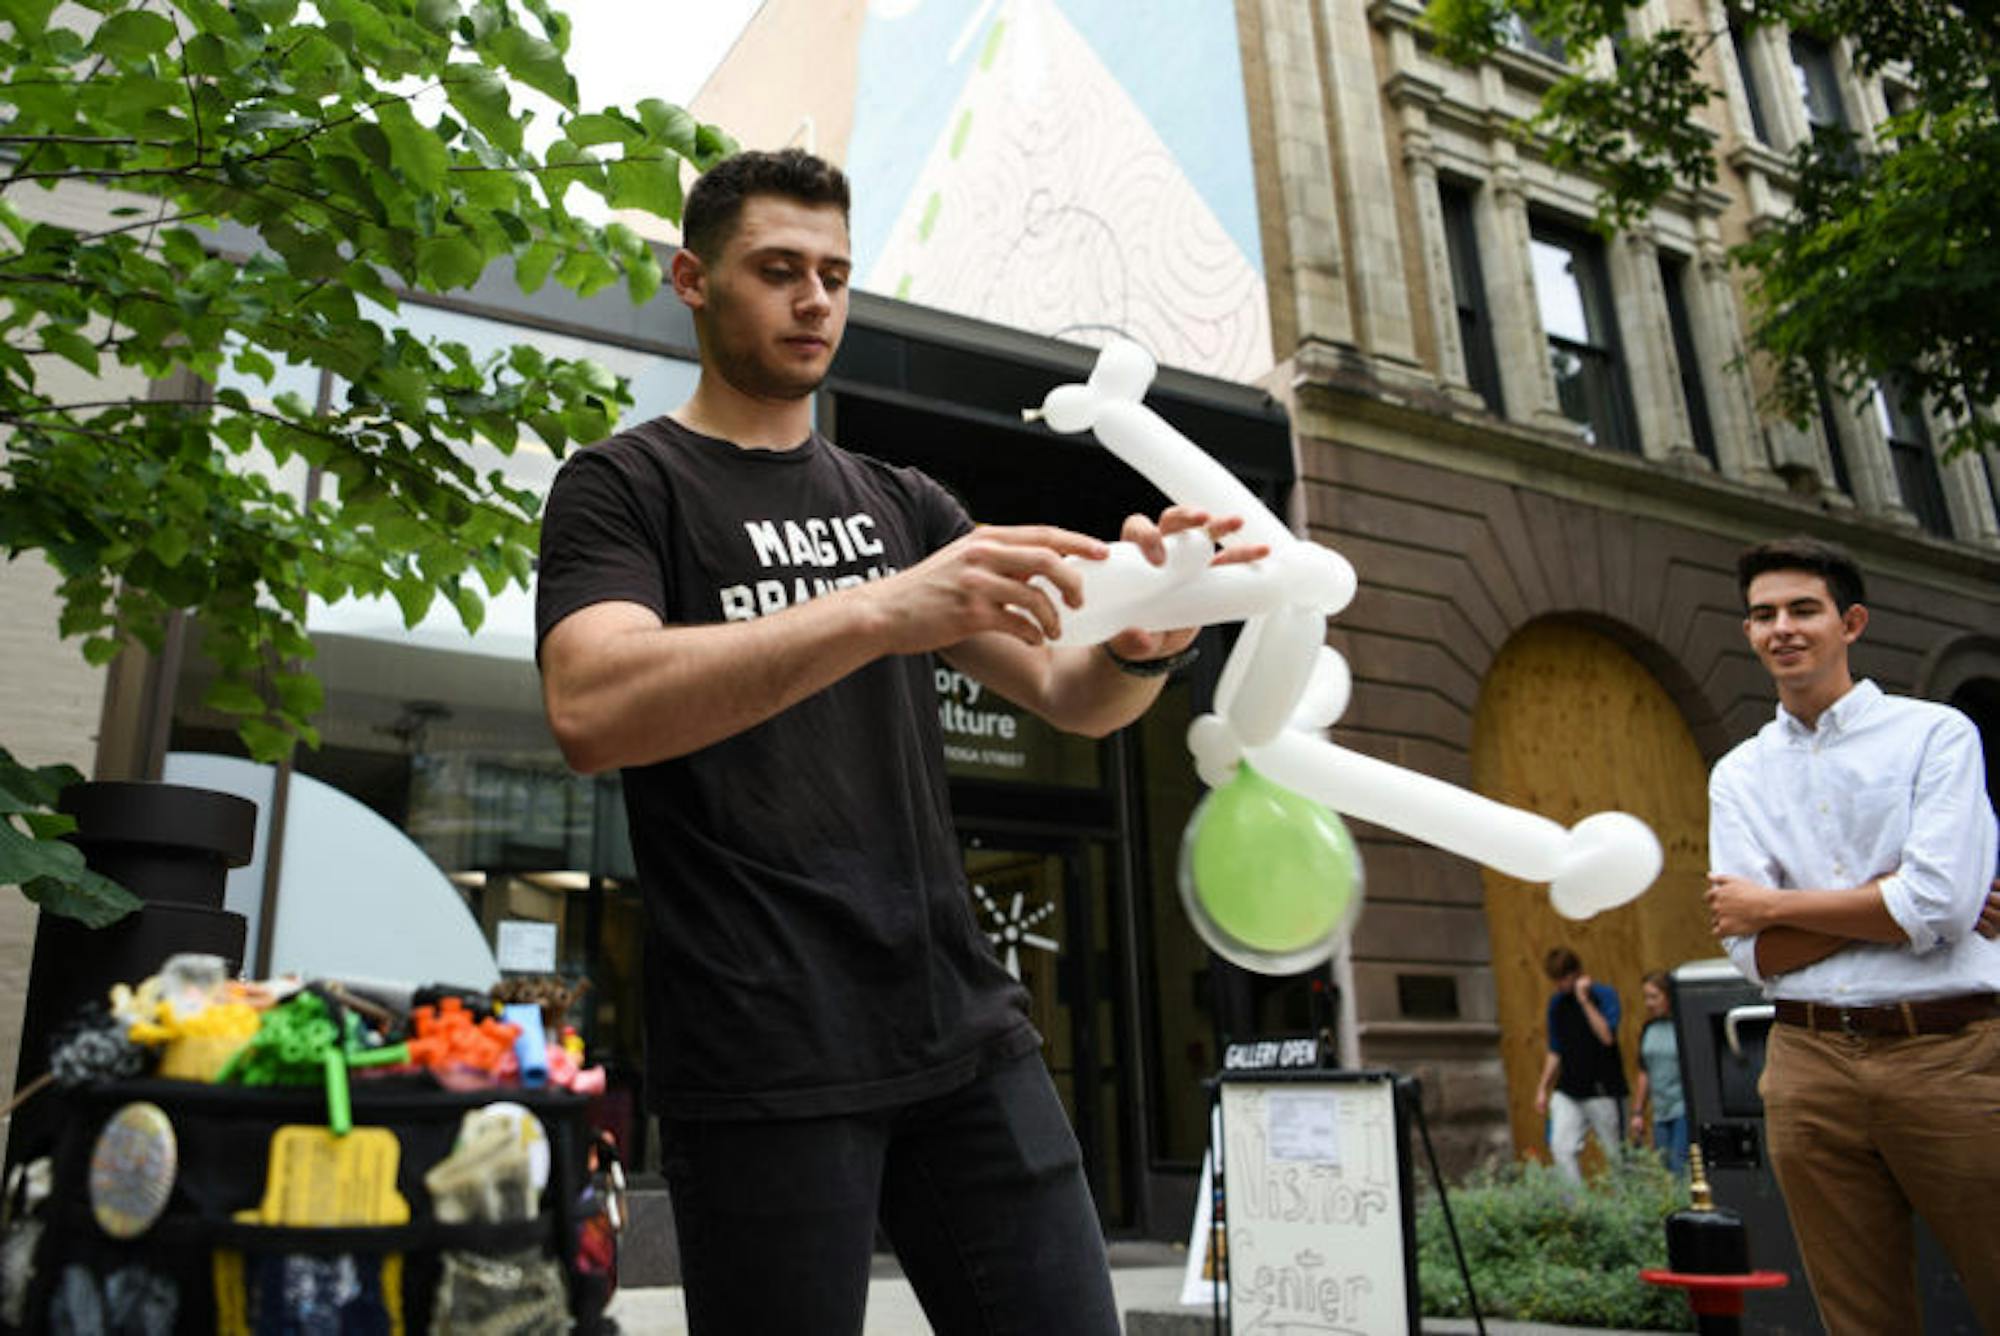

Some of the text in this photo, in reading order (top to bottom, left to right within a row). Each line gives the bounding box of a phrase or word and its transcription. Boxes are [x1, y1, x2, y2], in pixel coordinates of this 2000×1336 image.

[744, 513, 883, 567] MAGIC
[1225, 1039, 1318, 1069] GALLERY OPEN
